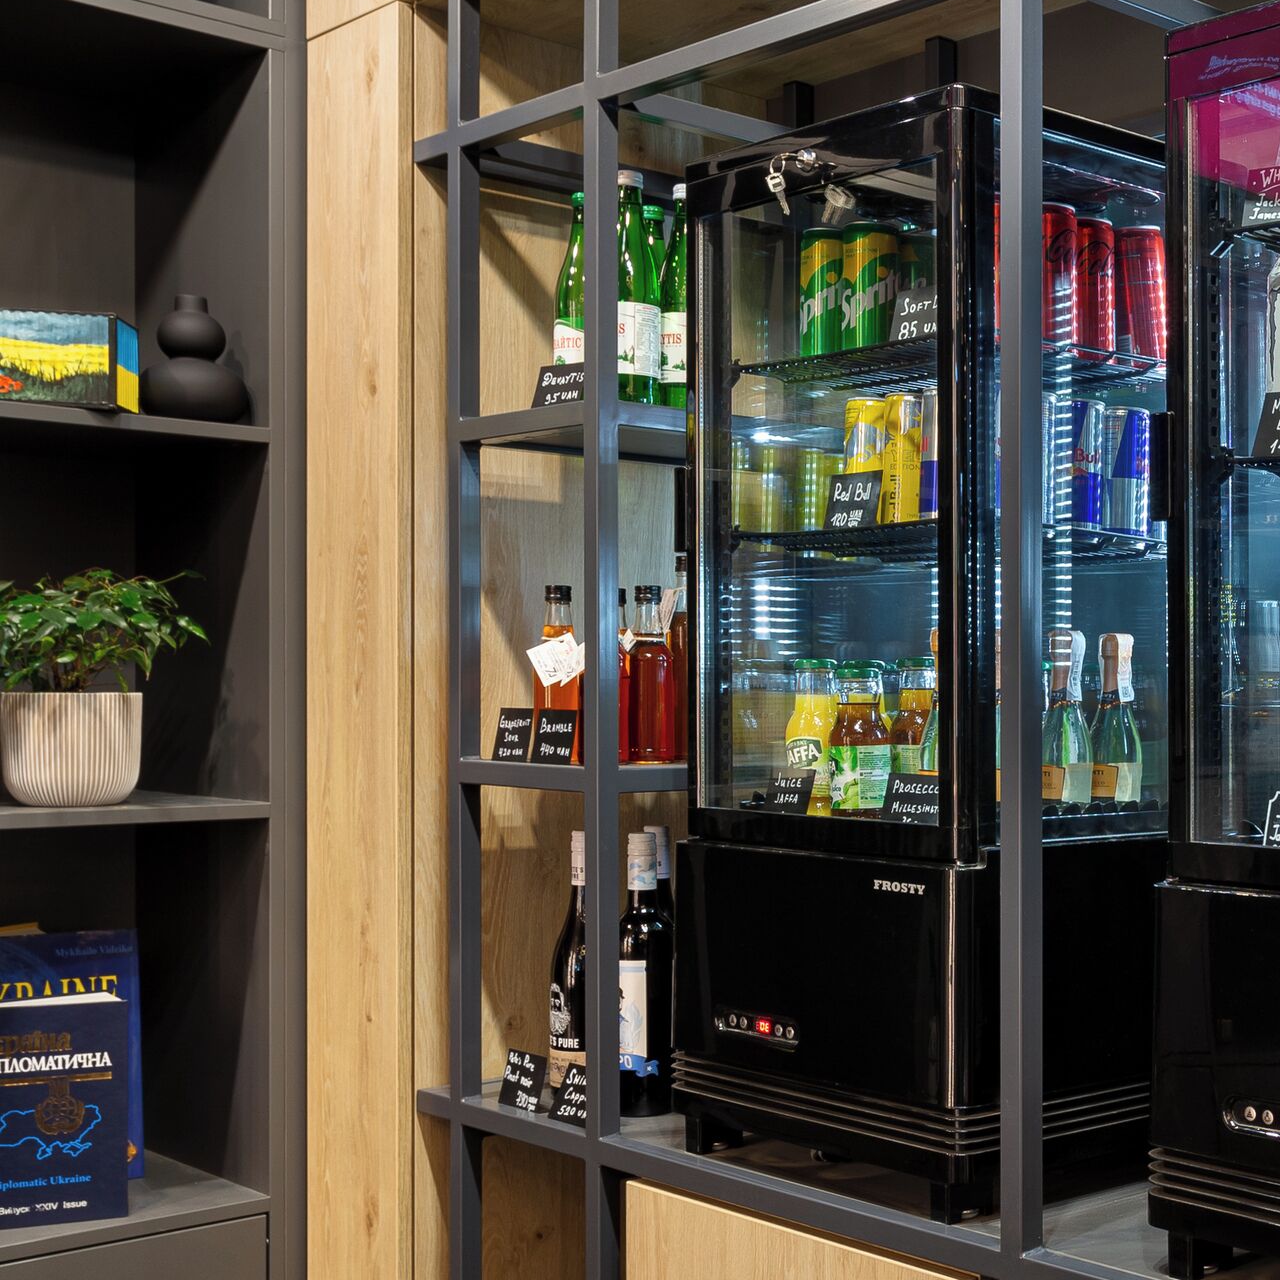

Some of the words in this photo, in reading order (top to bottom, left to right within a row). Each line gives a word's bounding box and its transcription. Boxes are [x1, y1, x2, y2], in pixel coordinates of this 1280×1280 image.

[1256, 191, 1280, 208] Jack
[900, 298, 932, 317] SOFT
[544, 392, 559, 405] 95
[562, 390, 578, 401] UAH
[833, 482, 852, 502] Red
[854, 482, 872, 501] Bull
[540, 718, 573, 733] BRAMBLE
[774, 794, 799, 805] JAFFA
[891, 801, 939, 815] MILLESIMAT
[873, 879, 926, 895] FROSTY
[558, 1037, 580, 1049] PURE
[0, 1051, 112, 1074] ПЛОМАТИЧНА
[564, 1087, 587, 1105] CAPP
[557, 1105, 576, 1117] 520
[50, 1174, 92, 1185] Ukraine
[63, 1200, 88, 1209] Issue
